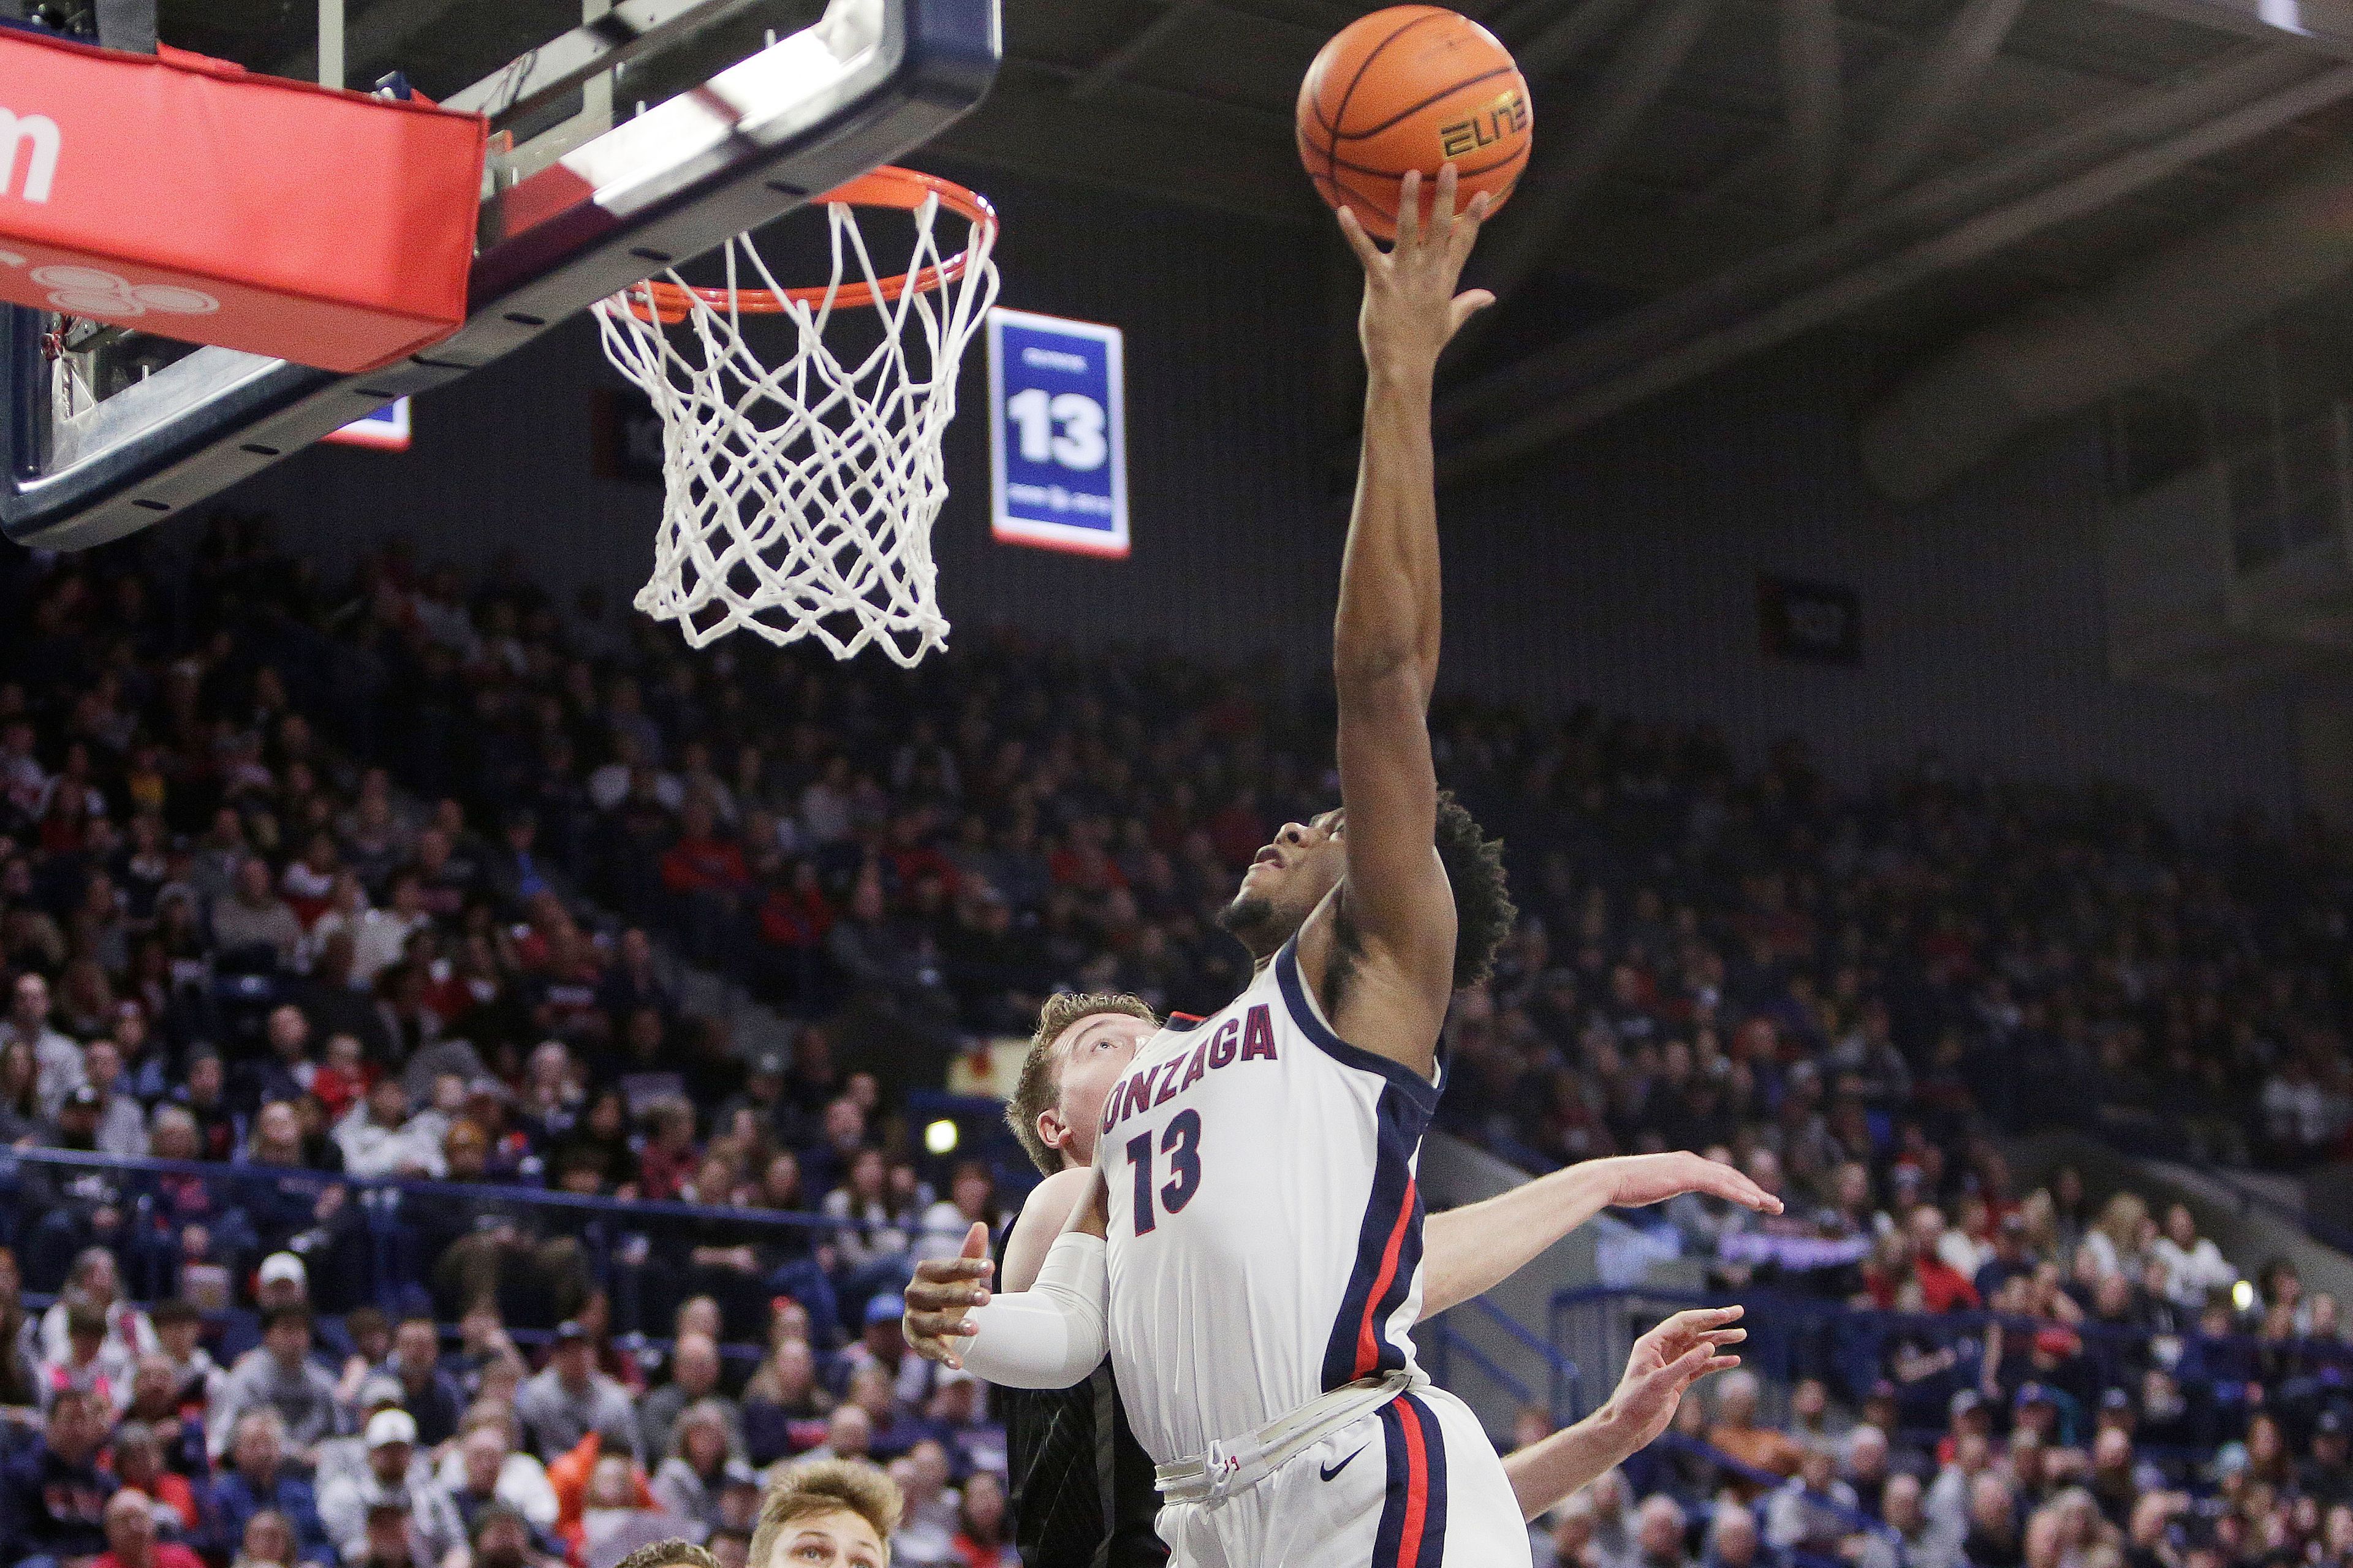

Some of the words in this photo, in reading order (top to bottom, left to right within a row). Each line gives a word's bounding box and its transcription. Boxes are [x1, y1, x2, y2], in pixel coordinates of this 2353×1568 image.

[1441, 97, 1528, 157] ELITE
[1007, 388, 1107, 472] 13
[1126, 1108, 1201, 1237] 13
